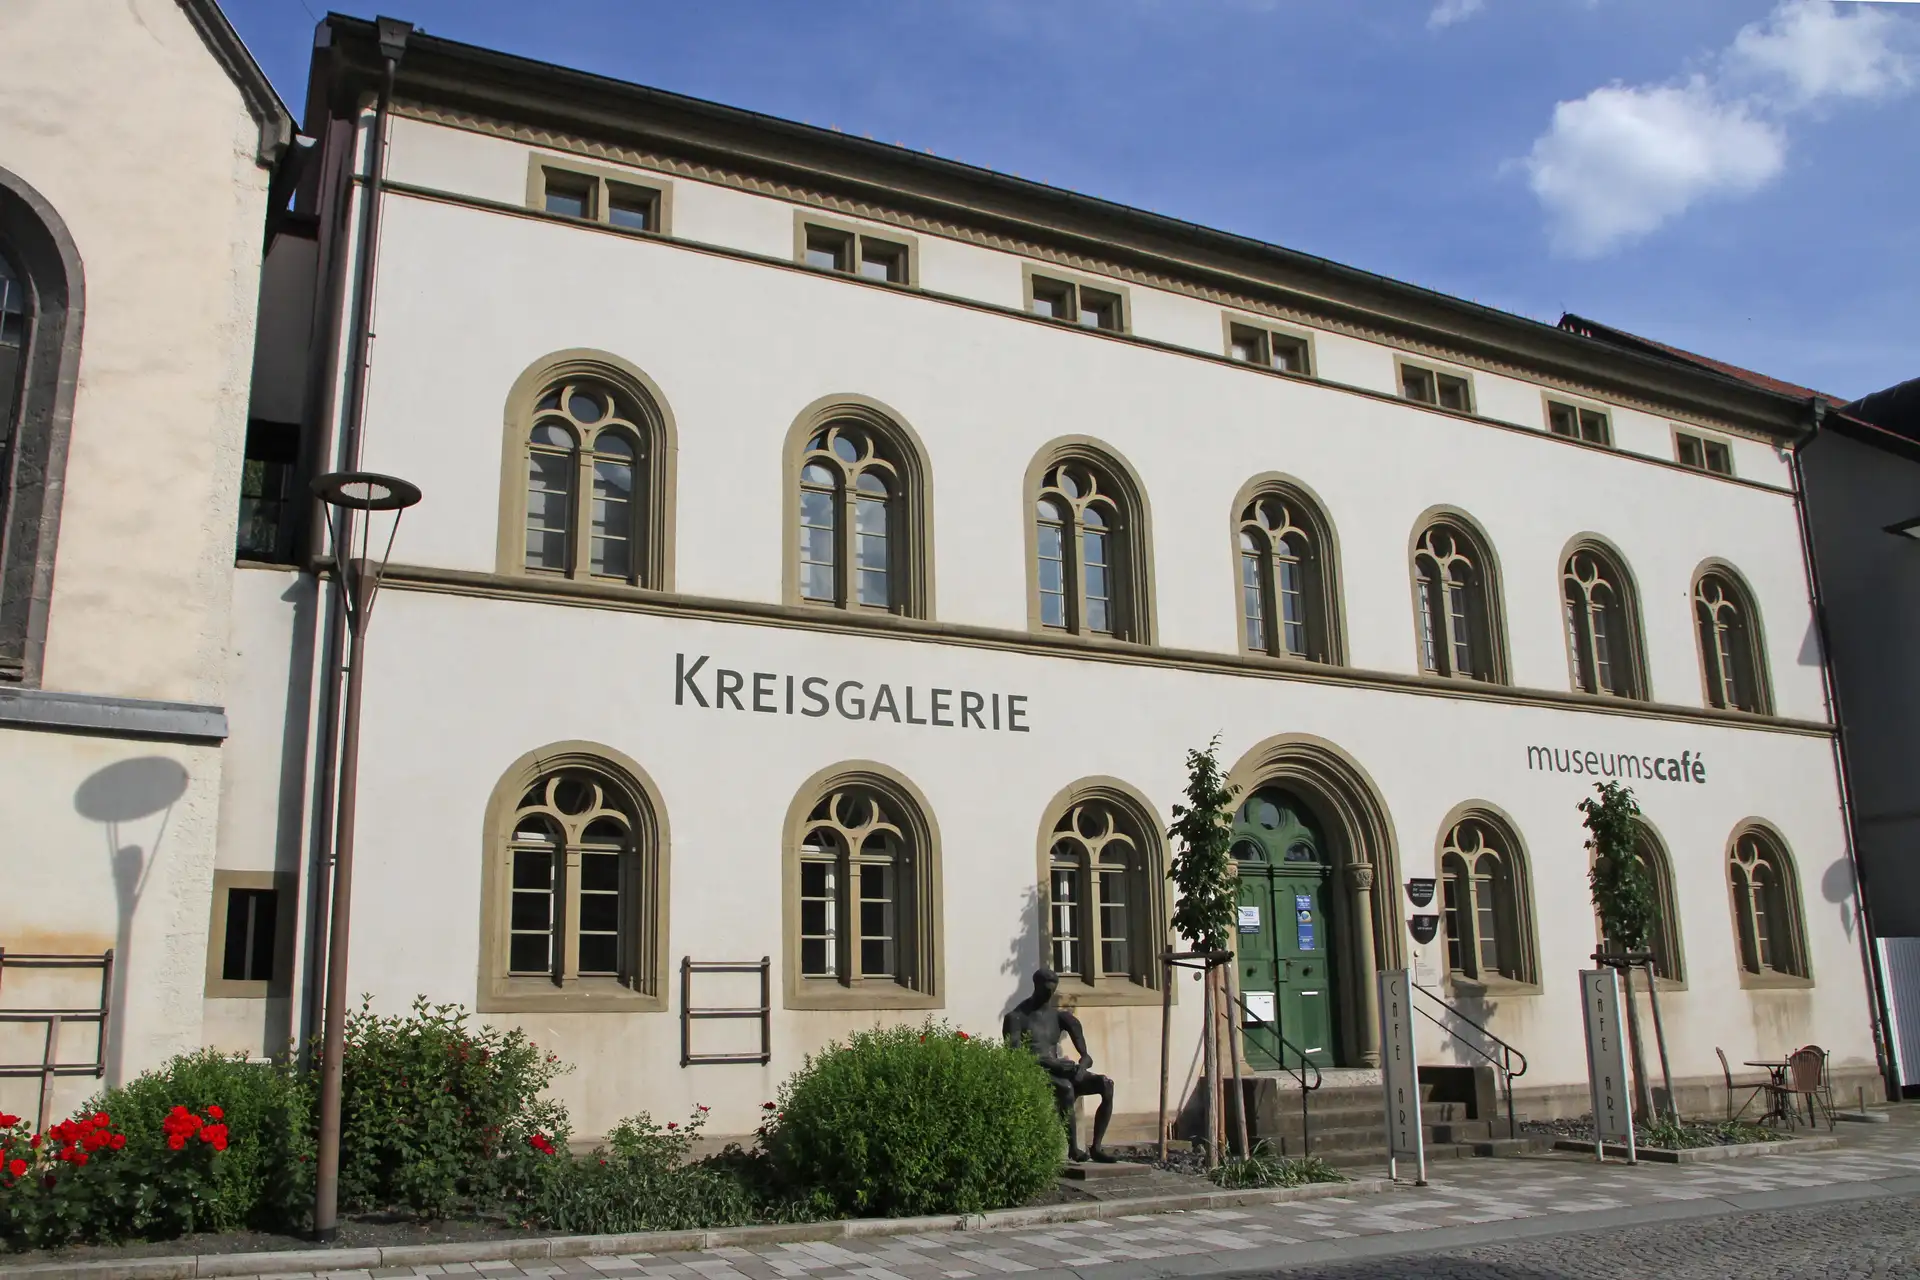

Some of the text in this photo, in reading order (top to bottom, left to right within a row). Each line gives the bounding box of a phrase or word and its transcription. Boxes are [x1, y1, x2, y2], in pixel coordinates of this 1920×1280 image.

[675, 653, 1030, 733] KREISGALERIE
[1527, 745, 1706, 784] museumscafé
[1390, 980, 1406, 1148] CAFE ART
[1595, 979, 1615, 1130] CAFE ART
